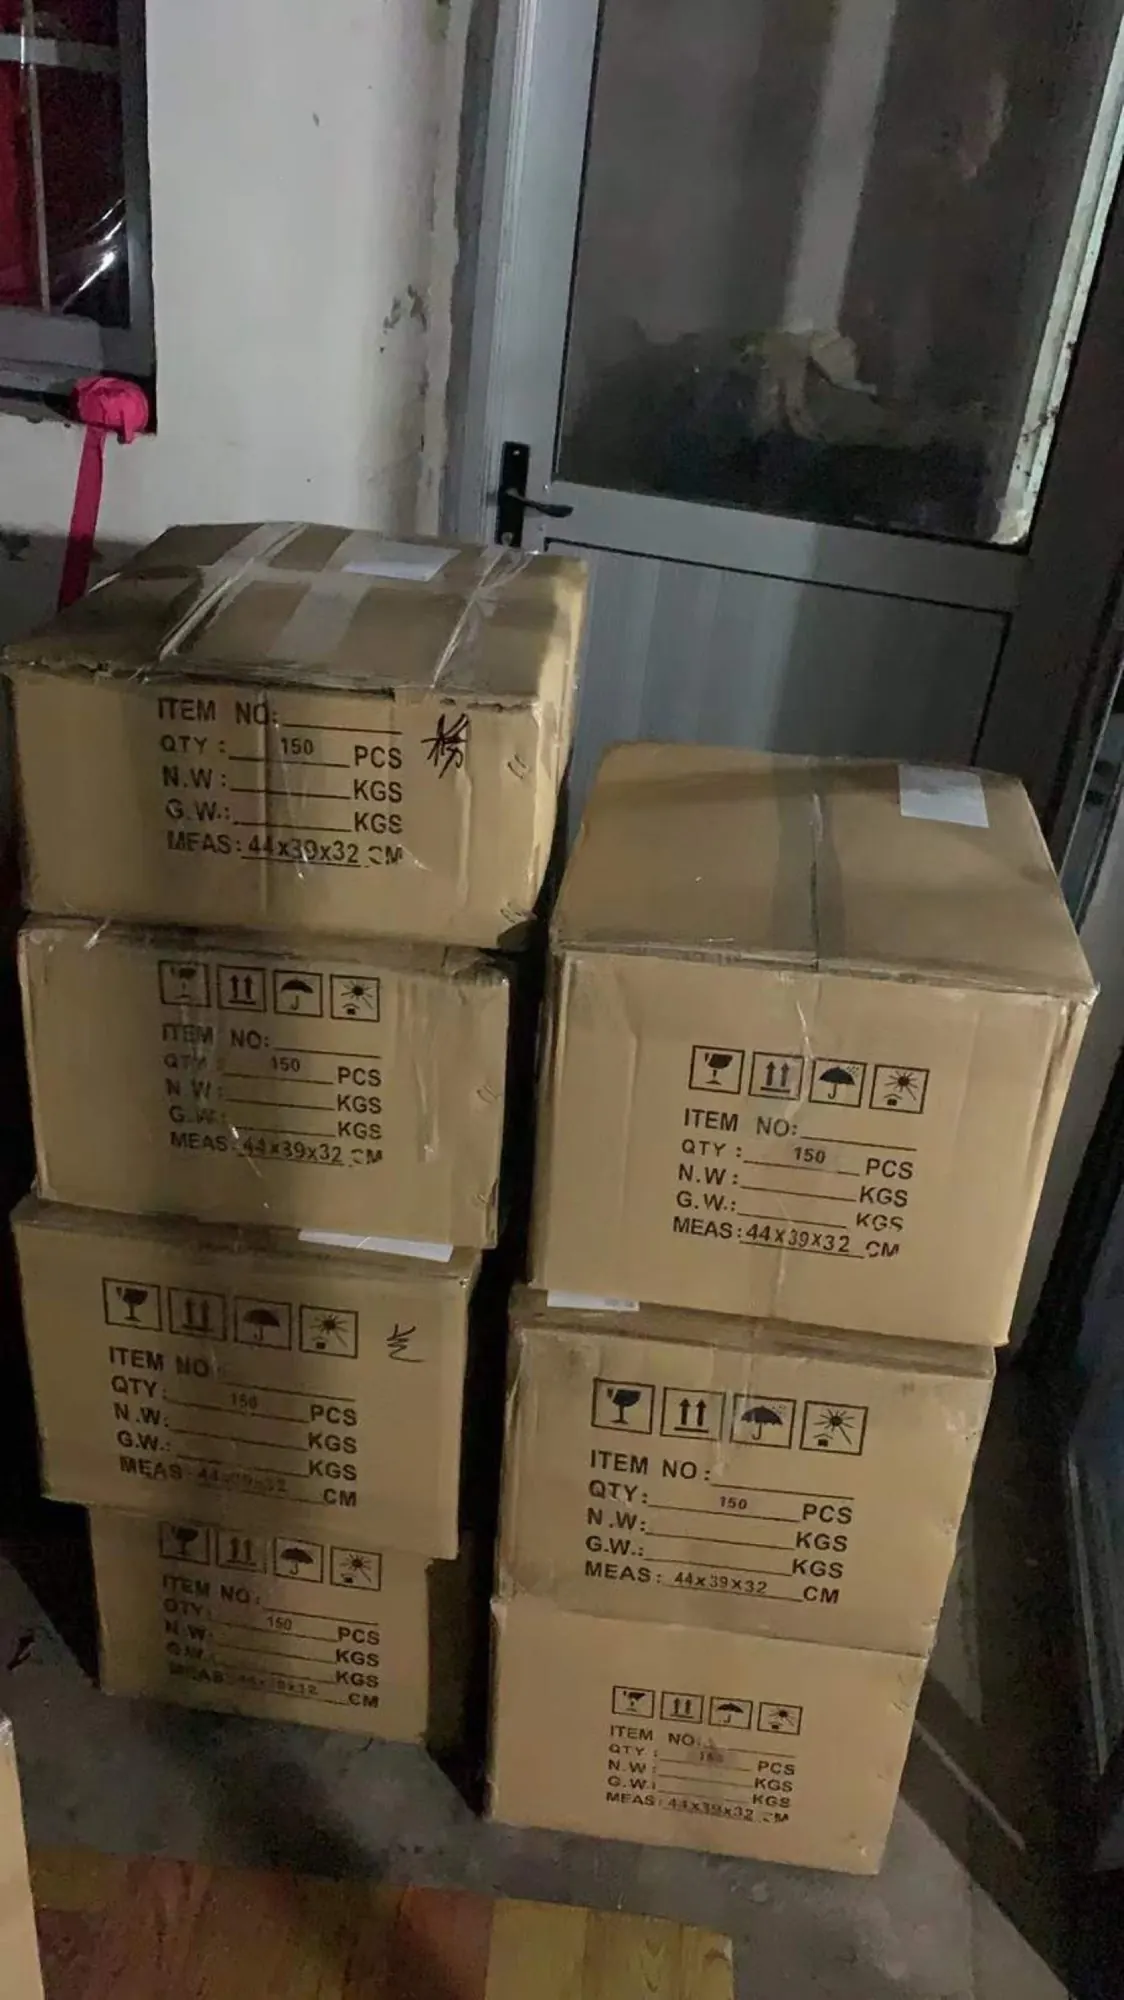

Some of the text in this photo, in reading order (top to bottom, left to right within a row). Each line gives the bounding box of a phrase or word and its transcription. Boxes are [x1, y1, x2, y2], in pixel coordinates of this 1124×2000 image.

[157, 697, 216, 721] ITEM
[279, 737, 314, 755] 150
[354, 745, 403, 769] PCS
[354, 778, 403, 804] KGS
[354, 811, 403, 835] KGS
[161, 1024, 269, 1050] ITEM NO:
[271, 1056, 300, 1072] 150
[337, 1067, 382, 1087] PCS
[337, 1094, 382, 1114] KGS
[337, 1121, 382, 1140] KGS
[684, 1108, 798, 1137] ITEM NO:
[794, 1147, 826, 1164] 150
[866, 1158, 914, 1180] PCS
[860, 1186, 908, 1208] KGS
[856, 1213, 905, 1232] KGS
[673, 1216, 741, 1240] MEAS:
[865, 1240, 900, 1258] CM
[109, 1346, 164, 1371] ITEM
[310, 1404, 358, 1426] PCS
[308, 1432, 358, 1454] KGS
[308, 1459, 358, 1481] KGS
[590, 1449, 711, 1481] ITEM NO:
[323, 1488, 357, 1507] CM
[589, 1480, 853, 1525] QTY: 150 PCS
[796, 1531, 848, 1552] KGS
[792, 1559, 844, 1579] KGS
[163, 1575, 210, 1597] ITEM
[585, 1561, 662, 1584] MEAS:
[803, 1586, 839, 1604] CM
[267, 1616, 292, 1630] 150
[337, 1626, 380, 1645] PCS
[336, 1649, 379, 1667] KGS
[336, 1670, 379, 1689] KGS
[349, 1693, 379, 1709] CM
[610, 1725, 653, 1741] ITEM
[758, 1761, 796, 1776] PCS
[754, 1777, 793, 1793] KGS
[753, 1795, 791, 1808] KGS
